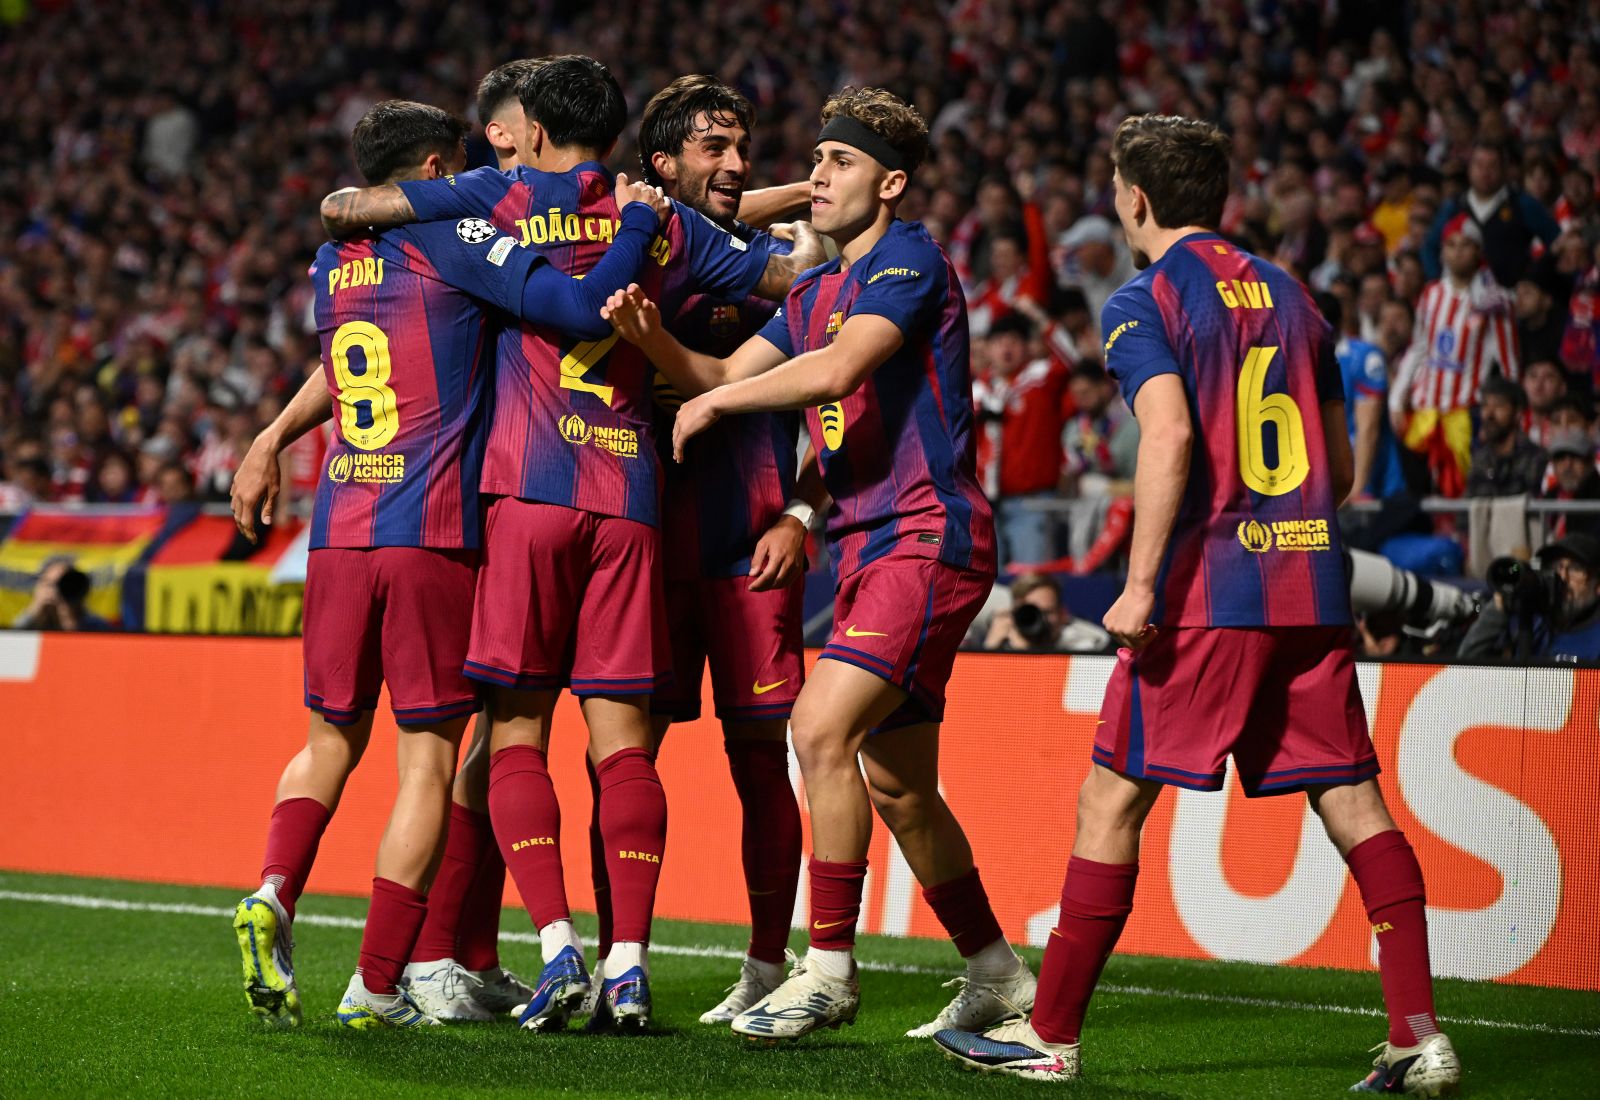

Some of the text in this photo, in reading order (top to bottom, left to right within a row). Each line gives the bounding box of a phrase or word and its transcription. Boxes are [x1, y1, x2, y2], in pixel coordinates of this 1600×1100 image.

[515, 207, 581, 247] JOÃO
[329, 257, 384, 295] PEDRI
[1216, 279, 1274, 309] GAVI
[331, 321, 399, 450] 8
[1237, 346, 1310, 496] 6
[353, 466, 404, 478] ACNUR
[354, 454, 405, 467] UNHCR
[1271, 520, 1328, 534] UNHCR
[1276, 532, 1330, 546] ACNUR
